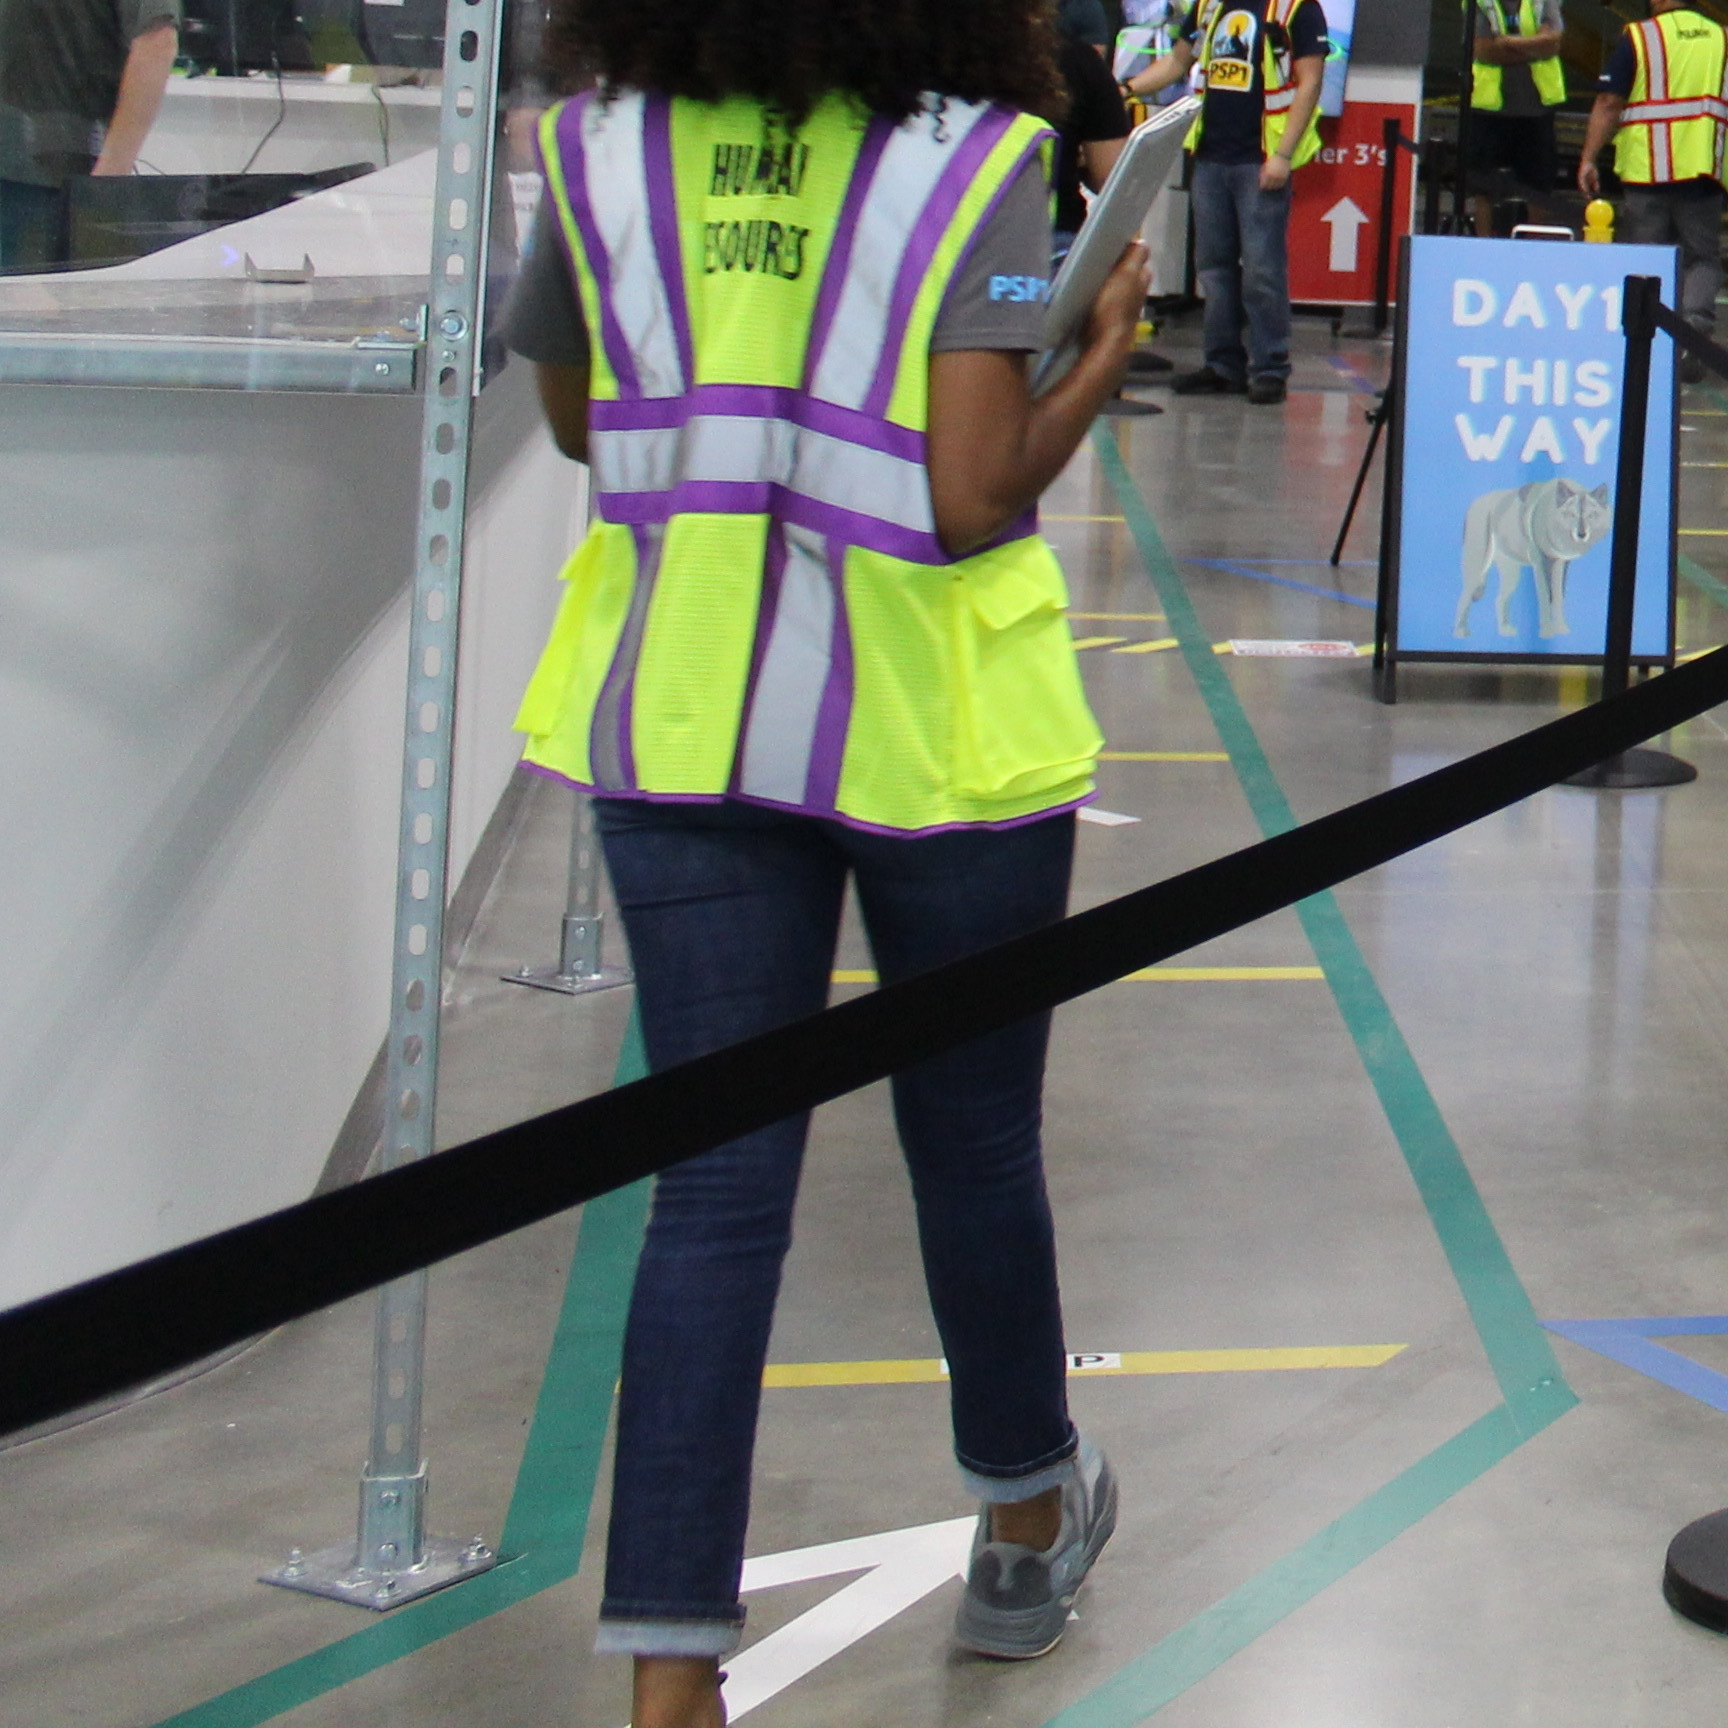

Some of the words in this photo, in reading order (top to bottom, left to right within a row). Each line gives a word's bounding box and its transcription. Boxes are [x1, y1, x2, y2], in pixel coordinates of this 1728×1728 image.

[1452, 278, 1620, 332] DAY1
[1456, 355, 1613, 408] THIS
[1454, 413, 1612, 465] WAY
